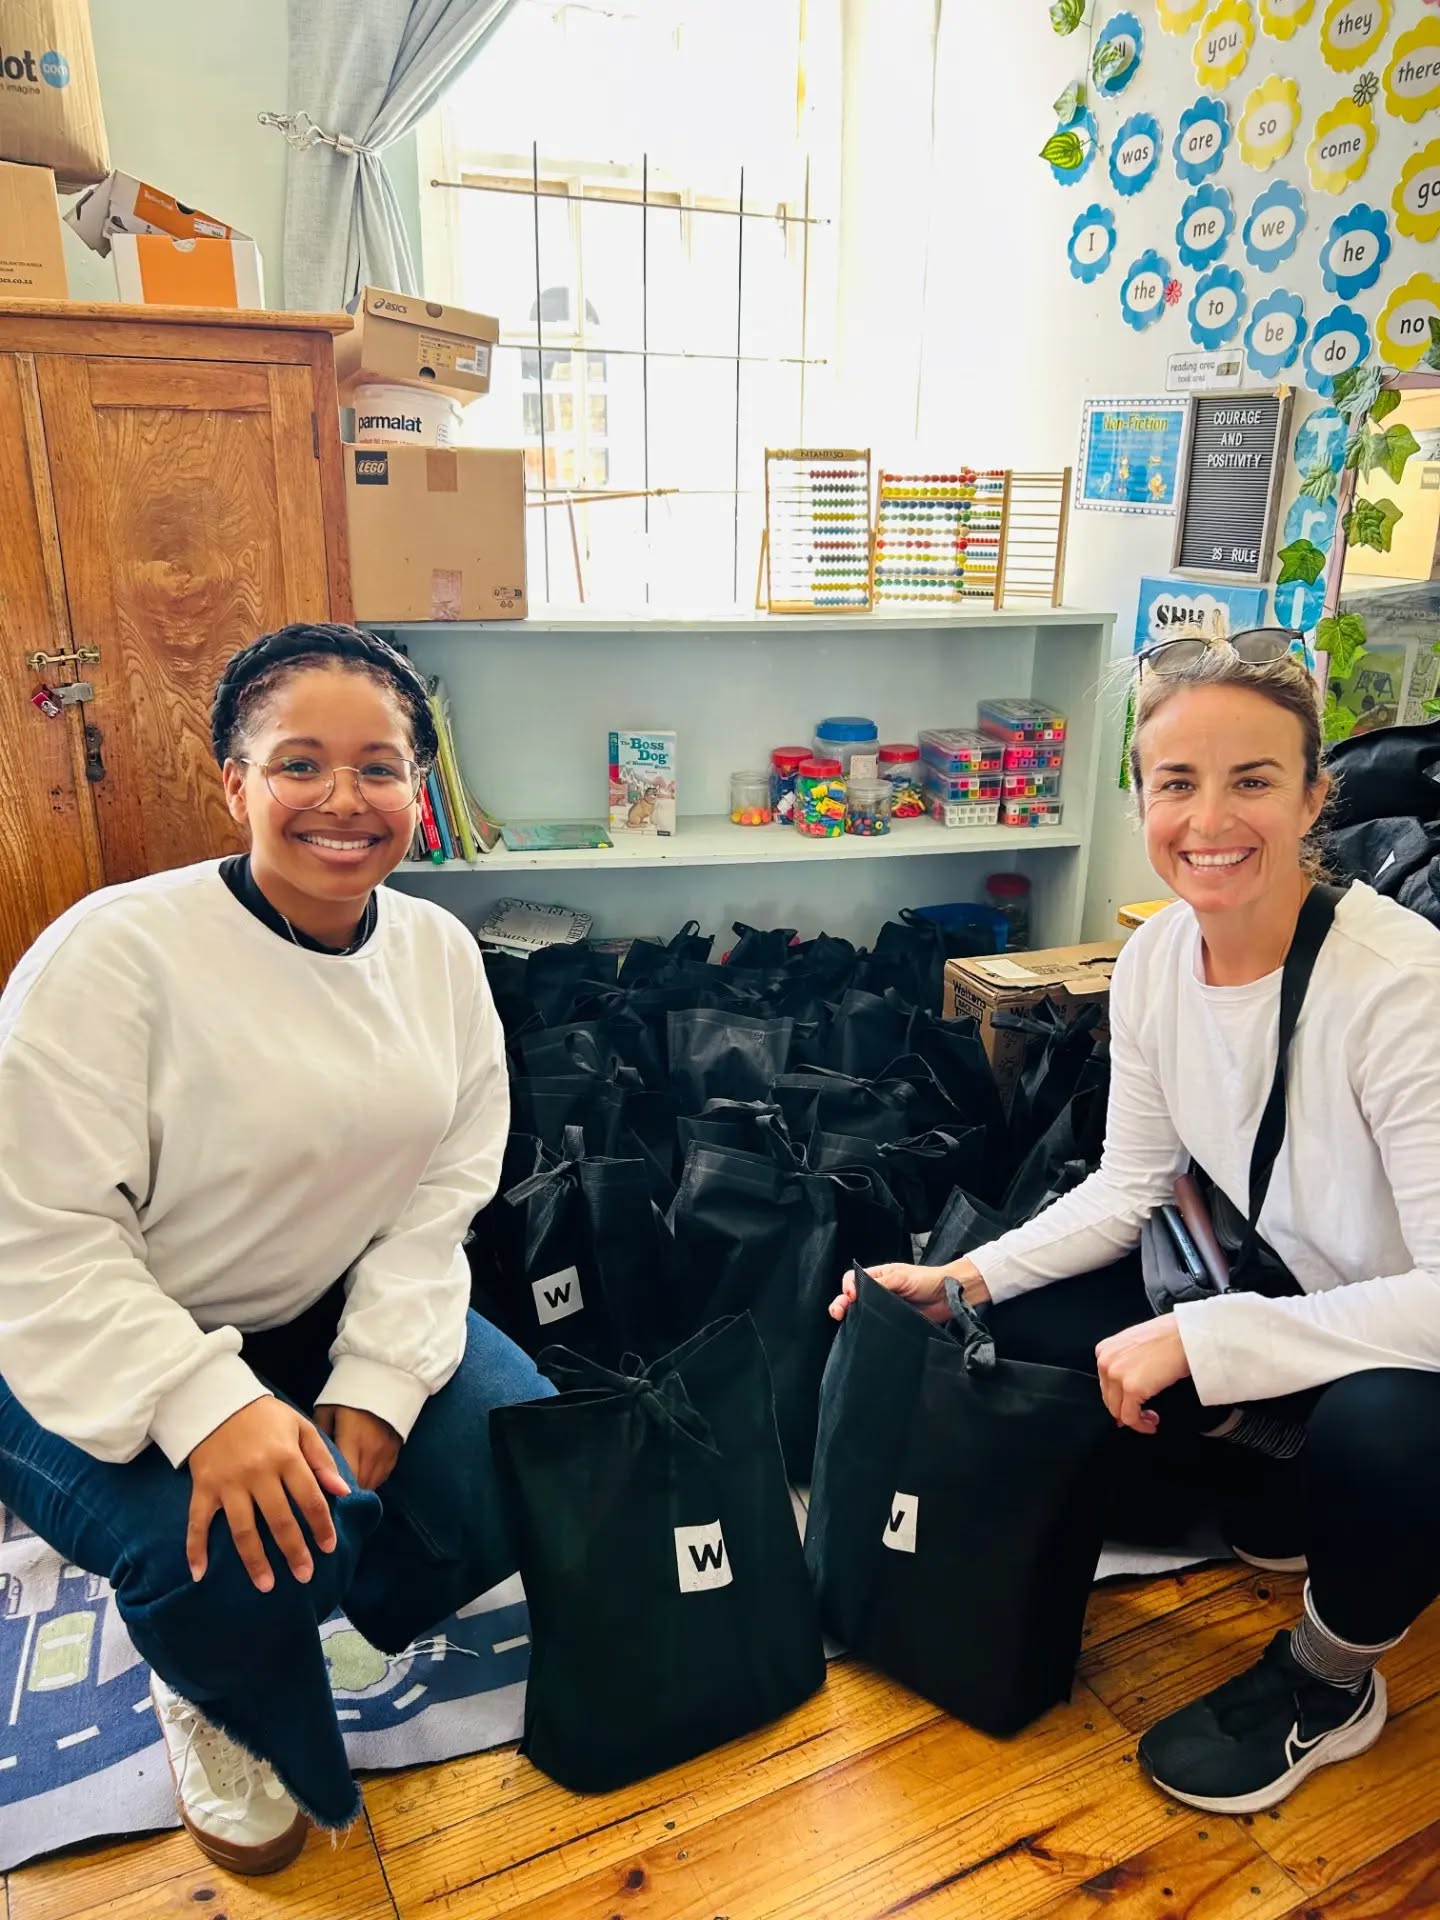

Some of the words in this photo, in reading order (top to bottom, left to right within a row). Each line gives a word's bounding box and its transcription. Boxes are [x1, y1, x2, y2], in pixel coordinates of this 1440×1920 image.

[1337, 13, 1373, 35] they
[1208, 32, 1238, 63] you
[1258, 120, 1277, 136] so
[1189, 133, 1214, 151] are
[1321, 138, 1361, 160] come
[1122, 145, 1149, 165] was
[1418, 181, 1440, 208] go
[1193, 220, 1216, 238] me
[1261, 220, 1285, 237] we
[1088, 232, 1095, 252] I
[1343, 240, 1365, 262] he
[1134, 281, 1156, 300] the
[1208, 300, 1224, 316] to
[1264, 322, 1284, 342] be
[1400, 317, 1425, 335] no
[1324, 340, 1347, 362] do
[1170, 361, 1198, 373] reading
[358, 414, 422, 433] parmalat
[1103, 415, 1169, 431] Non-Fiction
[1213, 409, 1262, 425] COURAGE
[1220, 432, 1244, 447] AND
[357, 460, 387, 476] LEGO
[1207, 454, 1263, 468] POSITIVITY
[1231, 549, 1258, 563] RULE
[630, 738, 665, 750] Boss
[638, 749, 667, 765] Dog
[953, 979, 987, 1010] Waltons
[543, 1281, 571, 1309] W
[688, 1538, 723, 1573] W
